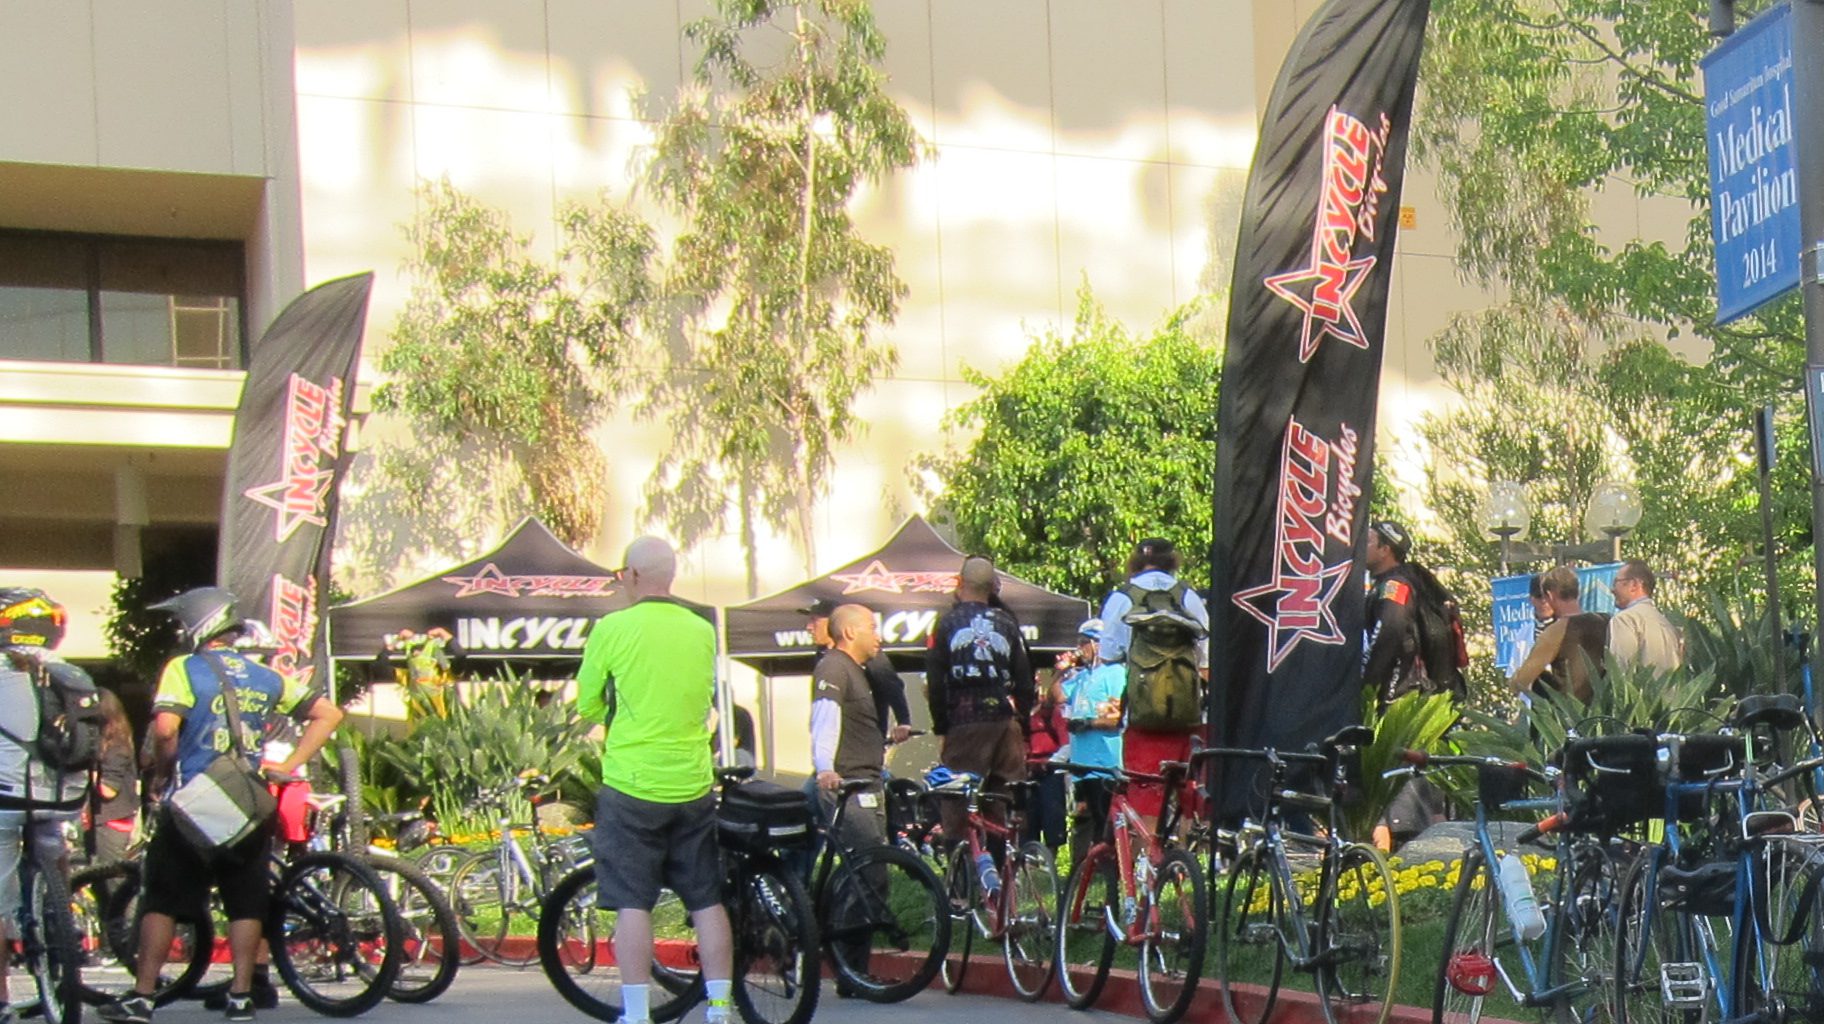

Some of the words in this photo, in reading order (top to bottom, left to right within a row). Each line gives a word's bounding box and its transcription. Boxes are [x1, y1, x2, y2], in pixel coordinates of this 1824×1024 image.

[1717, 83, 1792, 183] Medical
[1311, 112, 1370, 323] INCYCLE
[1719, 166, 1797, 244] Pavilion
[1742, 238, 1777, 288] 2014
[283, 376, 327, 514] INCYCLE
[1276, 421, 1329, 630] INCYCLE
[1325, 422, 1361, 545] Bicycles
